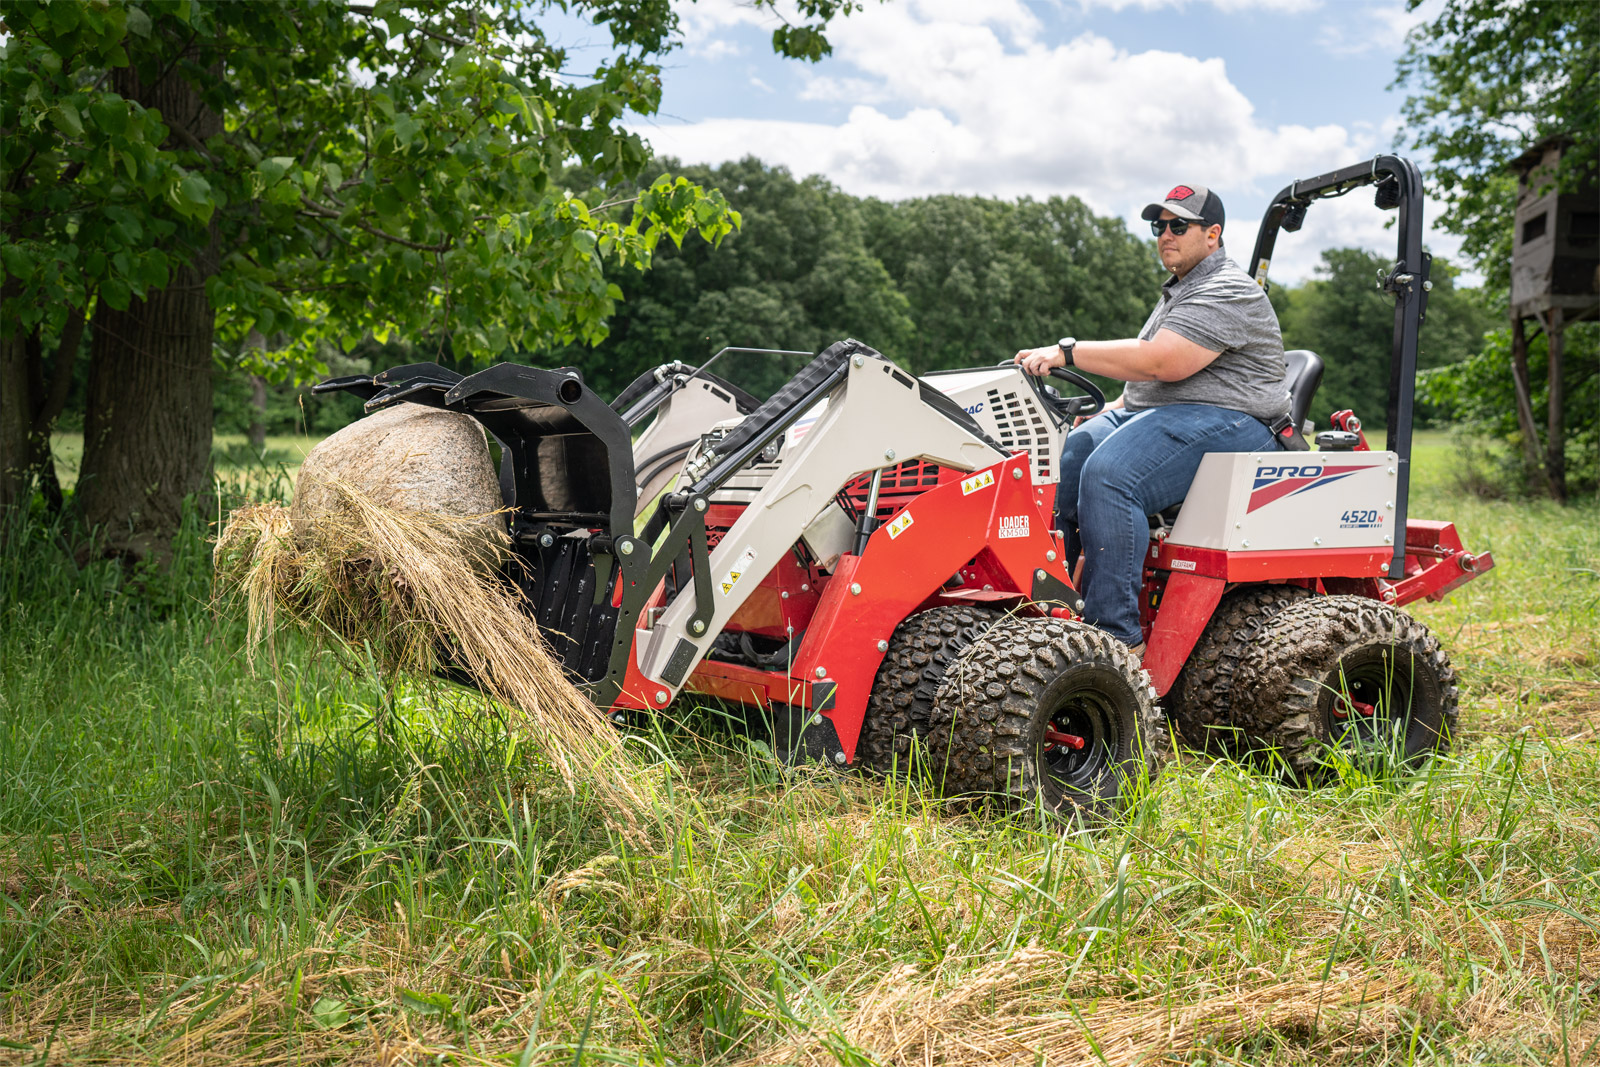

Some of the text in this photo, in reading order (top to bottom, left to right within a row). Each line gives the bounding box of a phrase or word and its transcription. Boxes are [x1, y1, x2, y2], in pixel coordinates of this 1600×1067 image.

[1255, 465, 1323, 478] PRO
[999, 515, 1030, 529] LOADER
[1000, 528, 1029, 538] KM500
